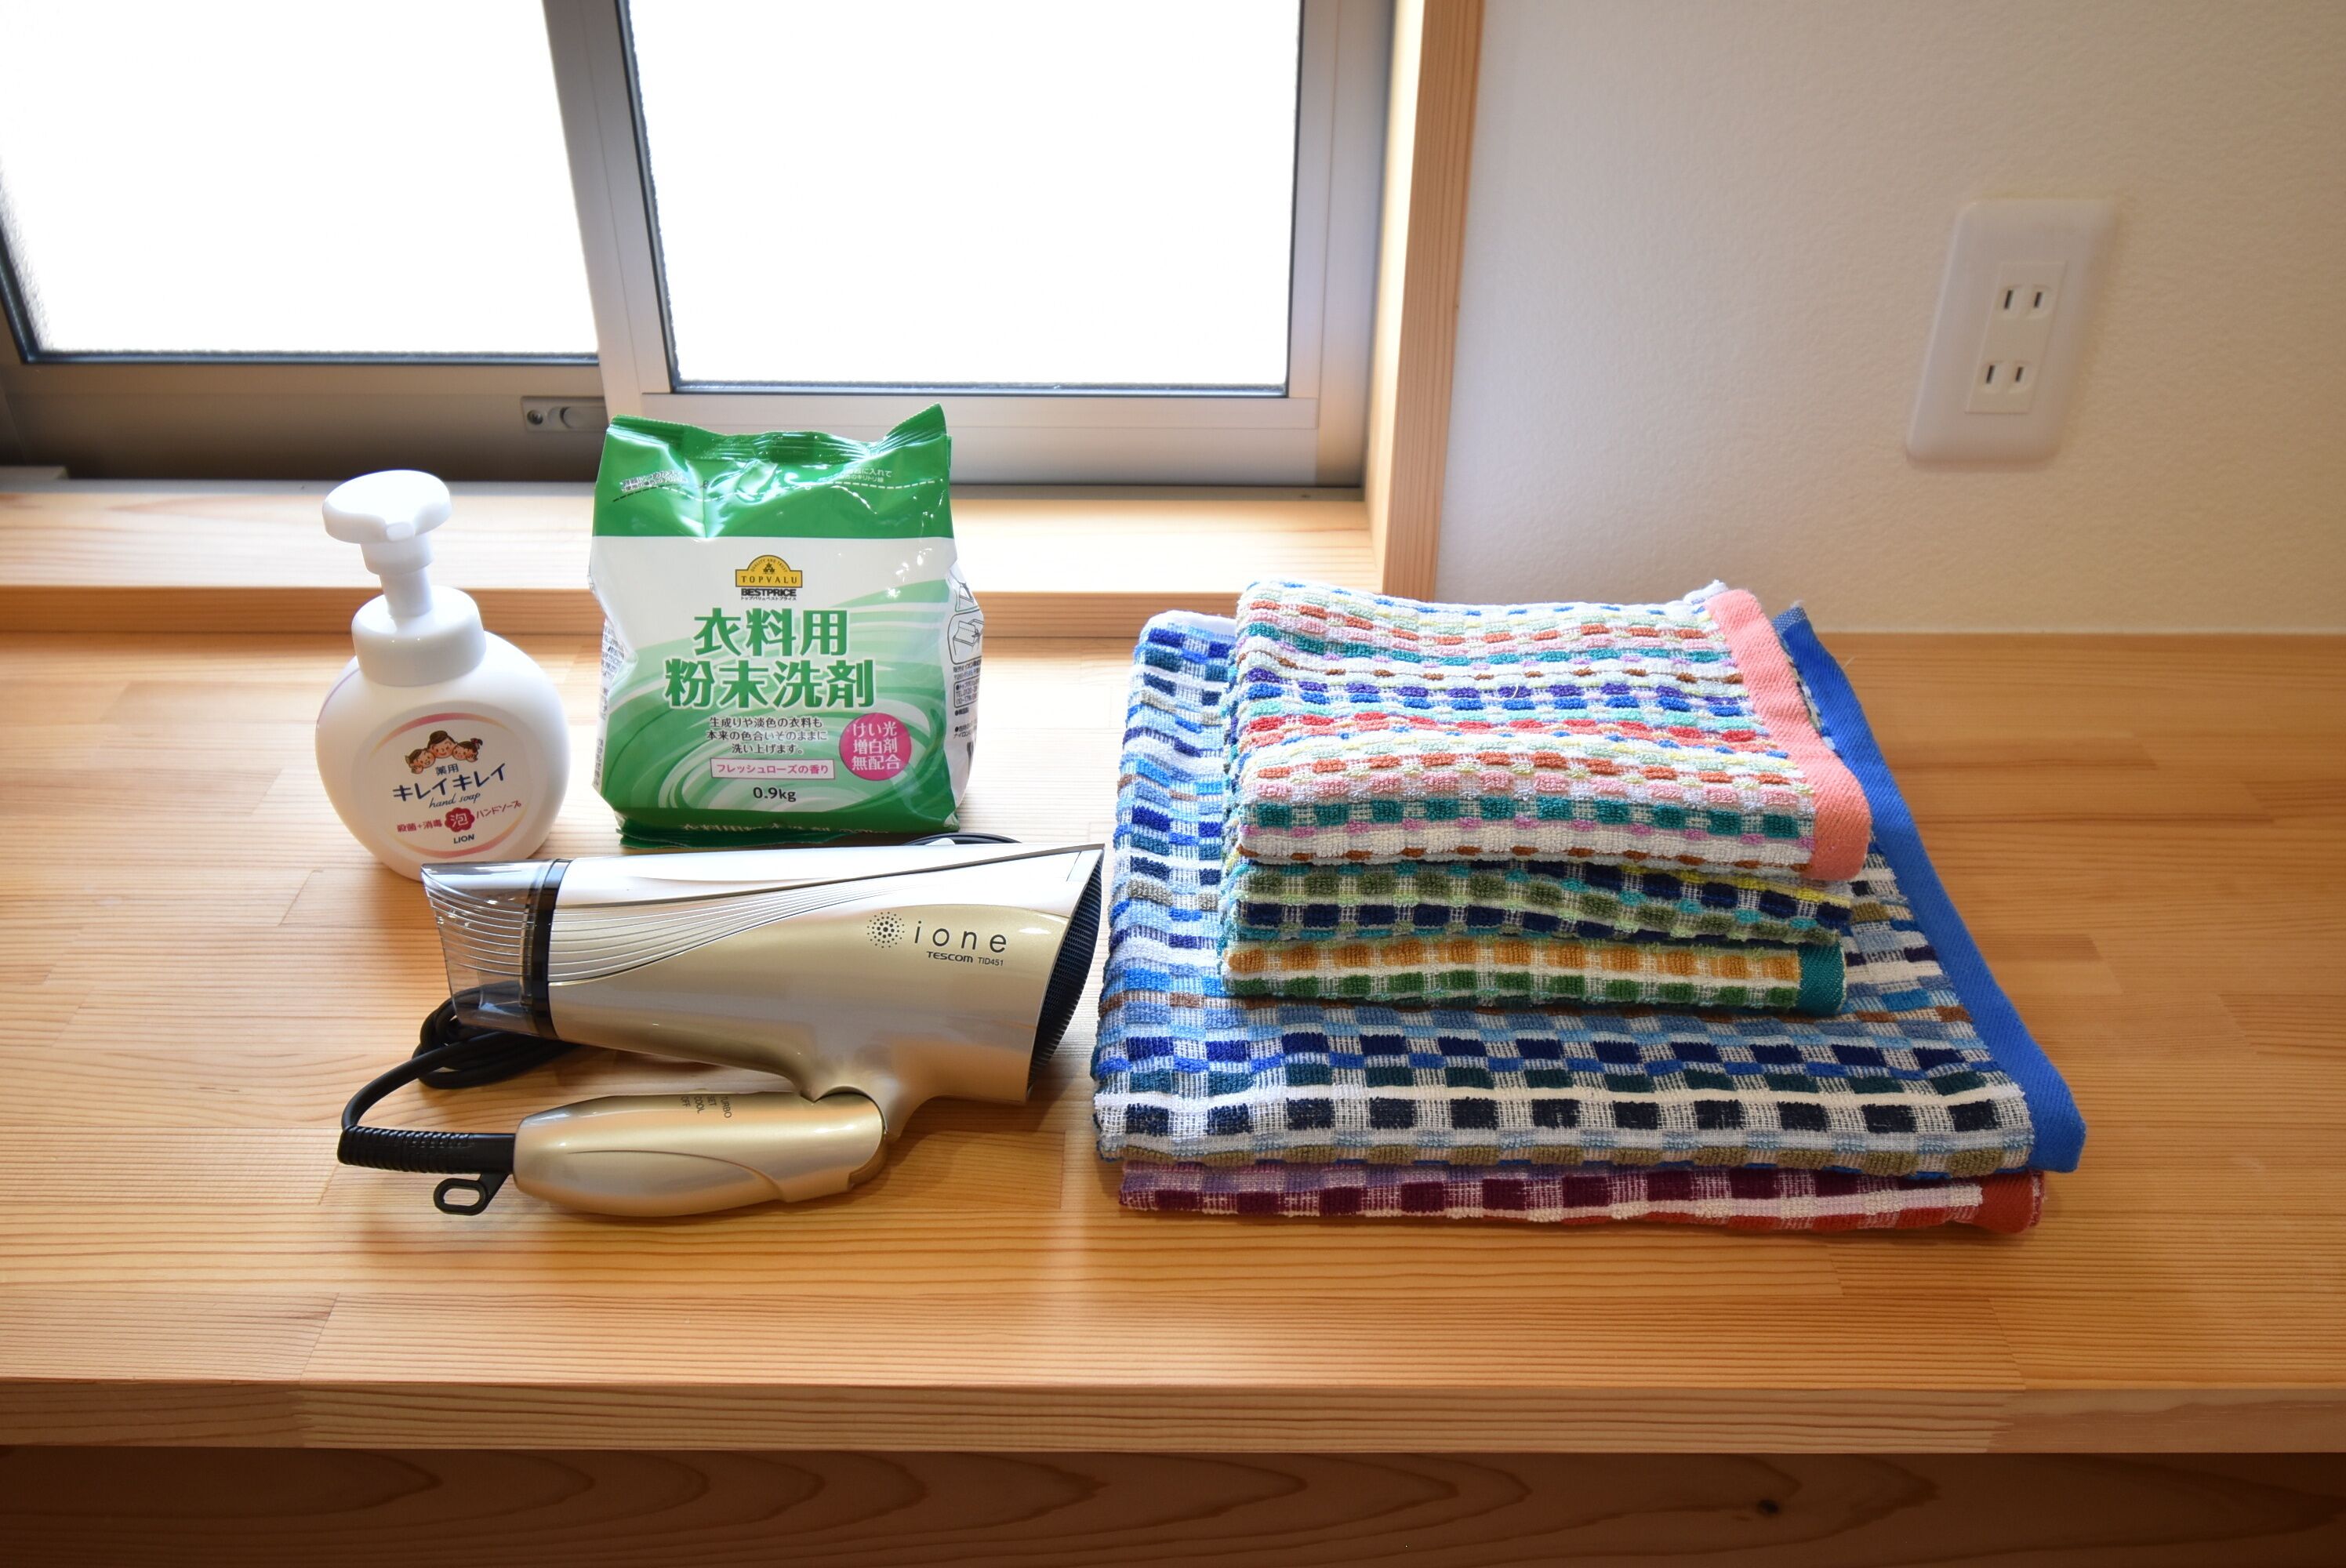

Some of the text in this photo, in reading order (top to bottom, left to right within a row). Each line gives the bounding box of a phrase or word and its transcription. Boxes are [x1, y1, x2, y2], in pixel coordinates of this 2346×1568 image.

[741, 588, 797, 597] BESTPRICE
[694, 608, 848, 656] 衣料用
[665, 659, 874, 709] 粉末洗剤
[710, 717, 823, 728] 生成りや淡色の衣料も
[853, 721, 897, 737] けい光
[707, 731, 828, 741] 本来の色合いそのままに
[732, 744, 804, 754] 洗い上げます。
[853, 737, 898, 754] 増白剤
[435, 764, 459, 775] 薬用
[717, 764, 829, 775] フレッシュローズの香り
[852, 754, 901, 771] 無配合
[393, 763, 506, 801] キレイキレイ
[429, 792, 481, 808] hand soap
[753, 787, 797, 802] 0.9kg
[450, 813, 468, 827] 泡
[476, 800, 522, 818] ハンドソープ
[453, 833, 475, 844] LION
[914, 920, 1007, 953] ione
[978, 956, 1004, 967] TID451
[694, 1096, 705, 1114] COOL
[721, 1096, 732, 1119] TURBO
